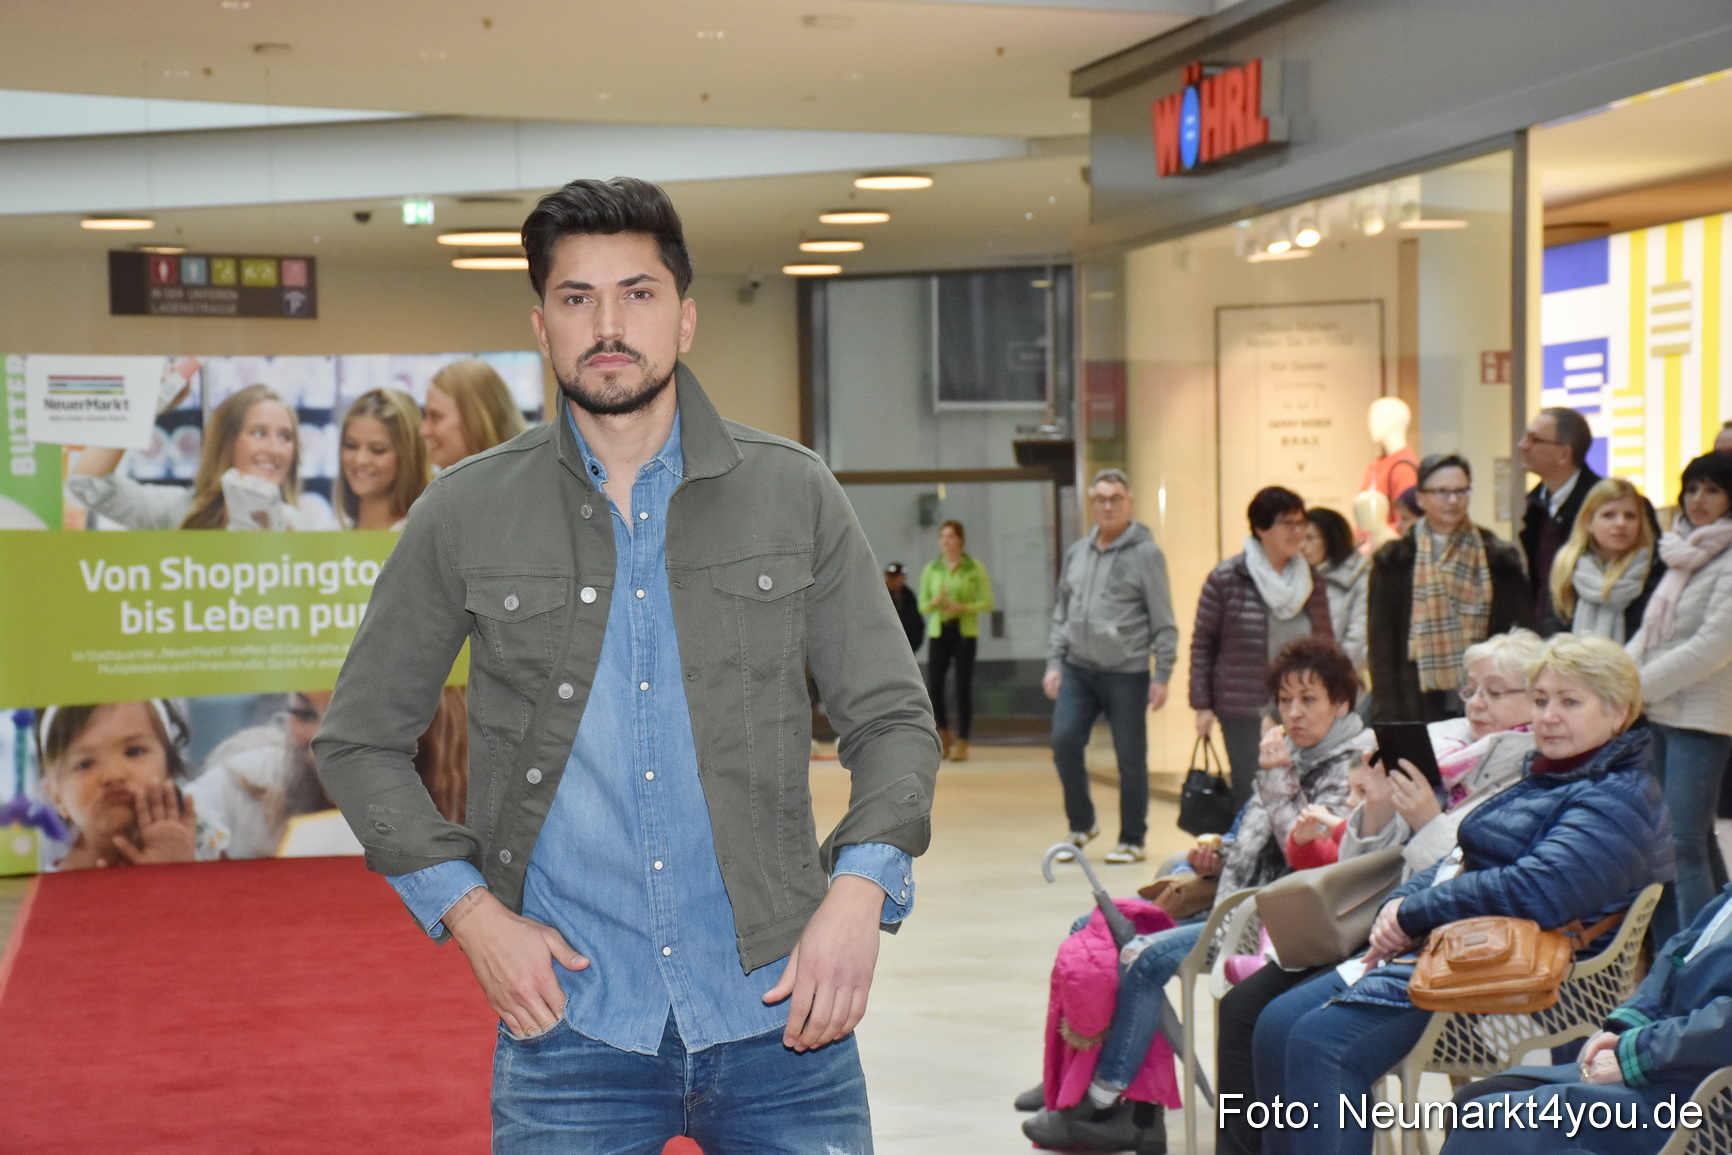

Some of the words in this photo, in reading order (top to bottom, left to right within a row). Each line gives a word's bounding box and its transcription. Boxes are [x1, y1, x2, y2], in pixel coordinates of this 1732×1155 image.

[1152, 57, 1270, 178] WÖHRL
[80, 559, 150, 591] Von
[160, 554, 386, 596] Shoppingto
[121, 600, 176, 634] bis
[183, 597, 299, 633] Leben
